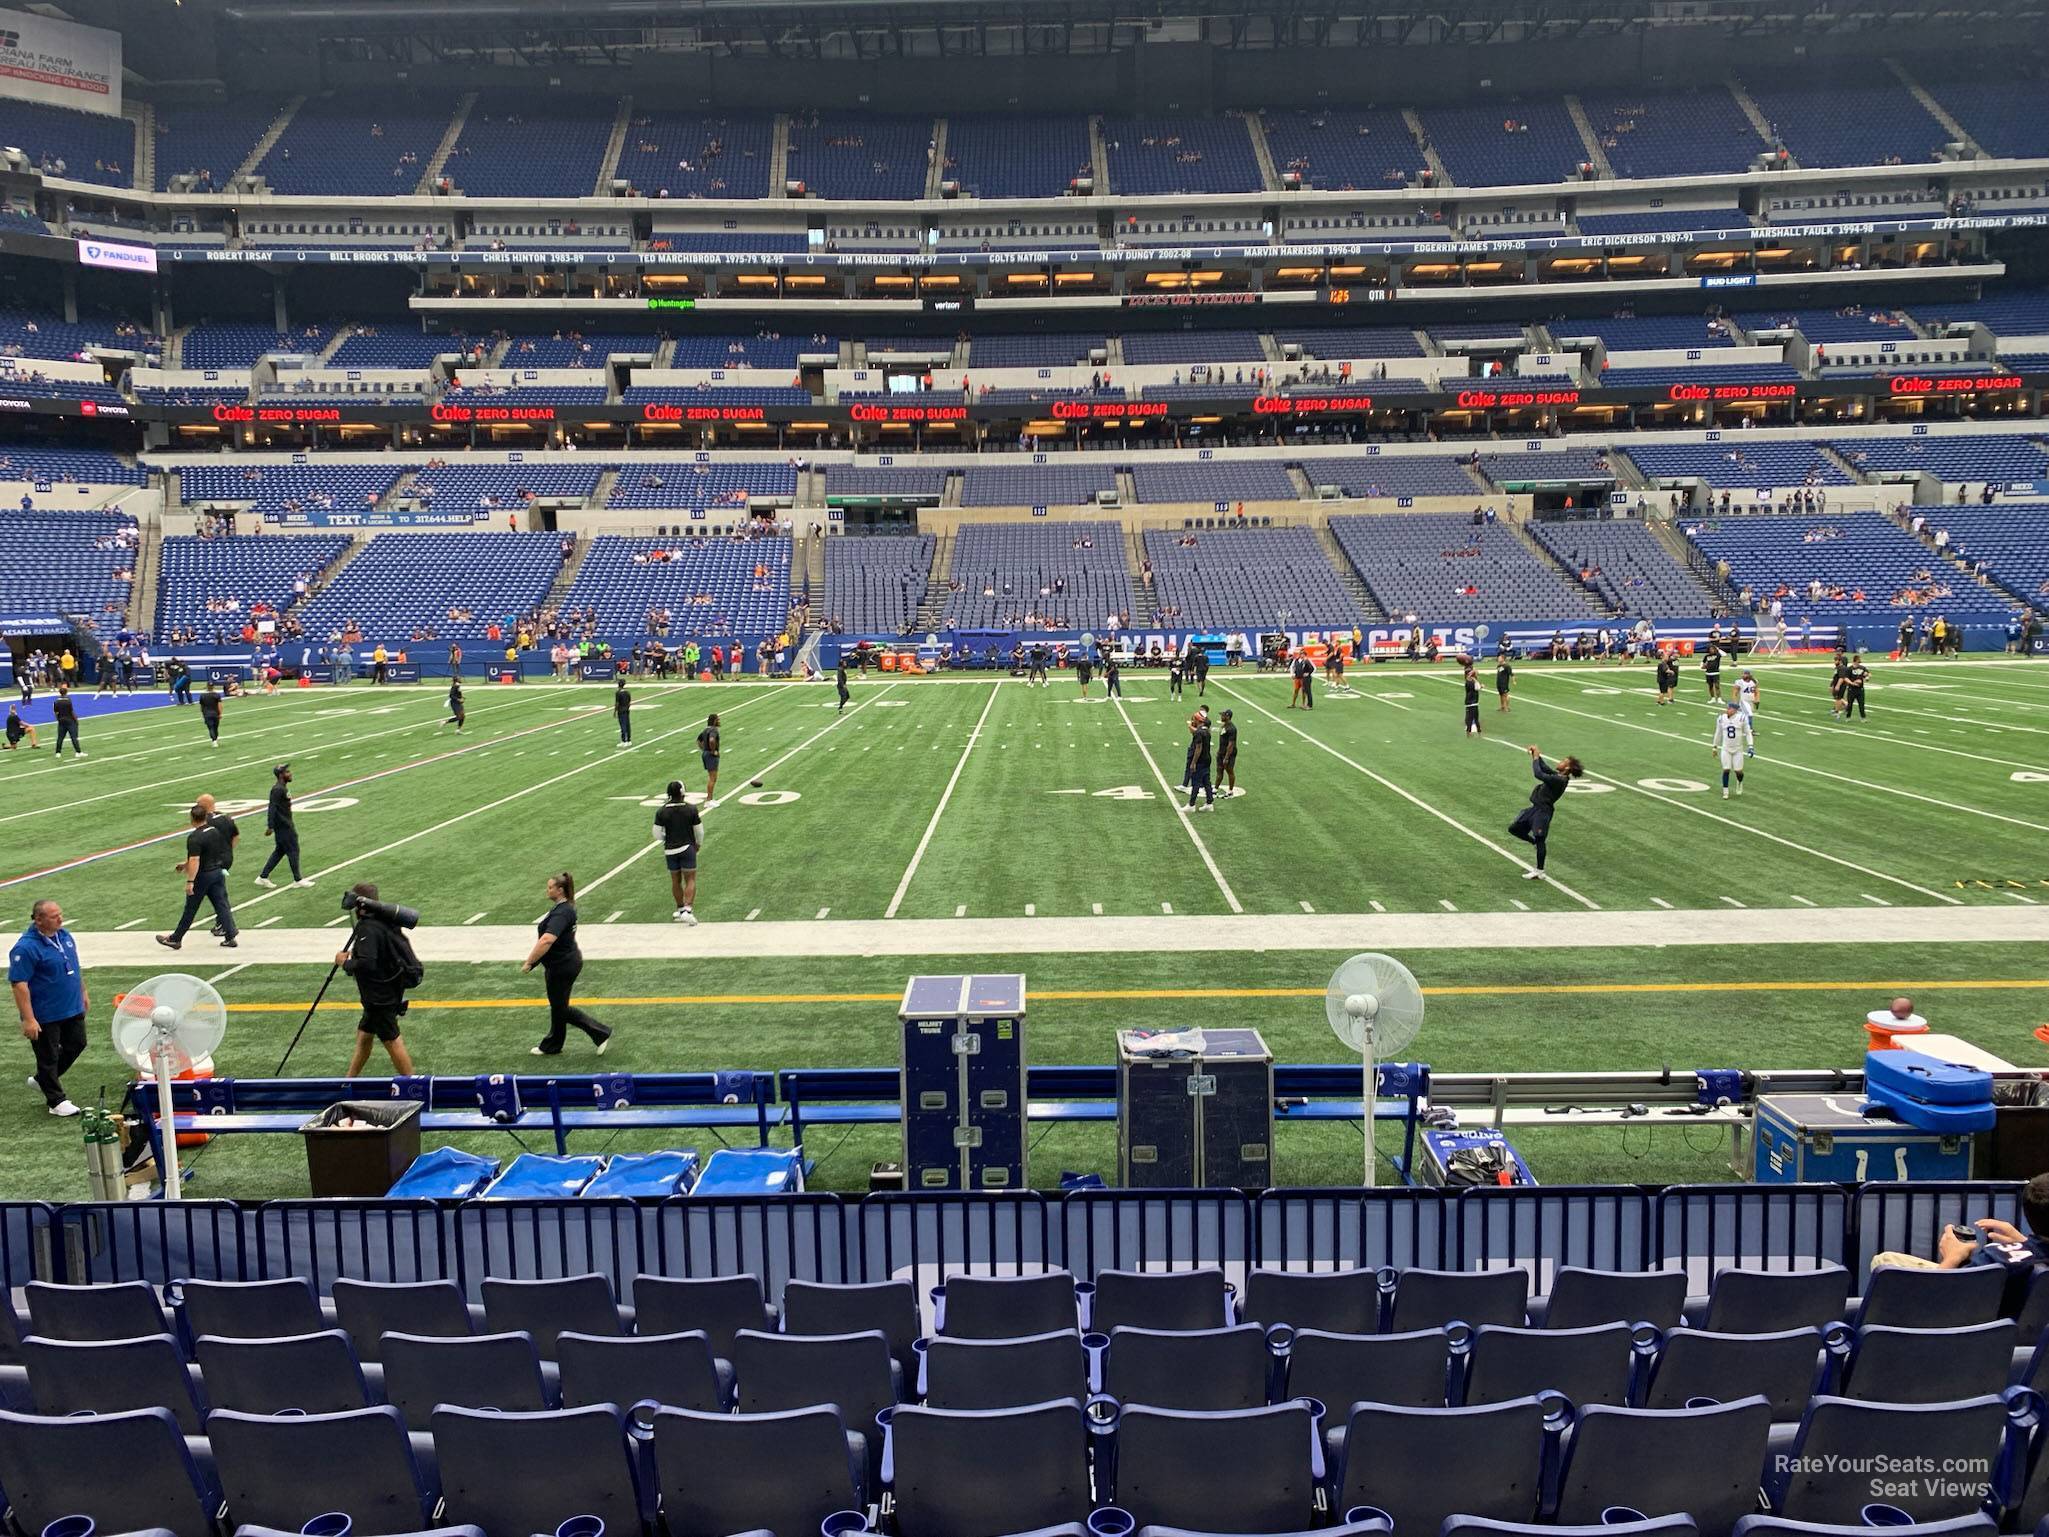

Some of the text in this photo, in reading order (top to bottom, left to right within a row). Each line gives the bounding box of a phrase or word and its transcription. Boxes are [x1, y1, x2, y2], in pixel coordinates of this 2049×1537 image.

[39, 54, 73, 68] FARM
[39, 63, 110, 83] INSURANCE
[1932, 215, 2048, 230] JEFF SATURDAY 1999-11
[1750, 228, 1801, 239] MARSHALL
[1803, 226, 1833, 237] FAULK
[1414, 240, 1526, 253] EDGERRIN JAMES 1999-05
[1581, 233, 1694, 247] ERIC DICKERSON 1987-91
[103, 250, 149, 264] FANDUEL
[206, 251, 272, 261] ROBERT IRSAY
[330, 252, 427, 263] BILL BROOKS 1986-92
[483, 253, 584, 263] CHRIS HINTON 1983-89
[1102, 249, 1191, 261] TONY DUNGY 2002-08
[1244, 245, 1360, 258] MARVIN HARRISON 1996-08
[639, 254, 655, 263] TED
[658, 254, 721, 264] MARCHIBRODA
[761, 254, 784, 264] 92-95
[837, 255, 937, 265] JIM HARBAUGH 1994-97
[989, 253, 1048, 264] COLTS NATION
[1706, 277, 1751, 286] BUD LIGHT
[1129, 293, 1256, 306] LUCAS OIL STADIUM
[1369, 290, 1385, 301] QTR
[658, 299, 695, 309] Huntington
[935, 302, 960, 310] verizon
[1891, 376, 2022, 392] Coke ZERO SUGAR
[1670, 384, 1796, 400] Coke ZERO SUGAR
[0, 400, 31, 408] TOYOTA
[1254, 397, 1371, 413] Coke ZERO SUGAR
[1458, 391, 1578, 407] Coke ZERO SUGAR
[97, 405, 129, 415] TOYOTA
[213, 404, 340, 421] Coke ZERO SUGAR
[432, 404, 554, 420] Coke ZERO SUGAR
[644, 403, 764, 420] Coke ZERO SUGAR
[850, 404, 967, 420] Coke ZERO SUGAR
[1052, 402, 1168, 418] Coke ZERO SUGAR
[1727, 726, 1736, 738] 8
